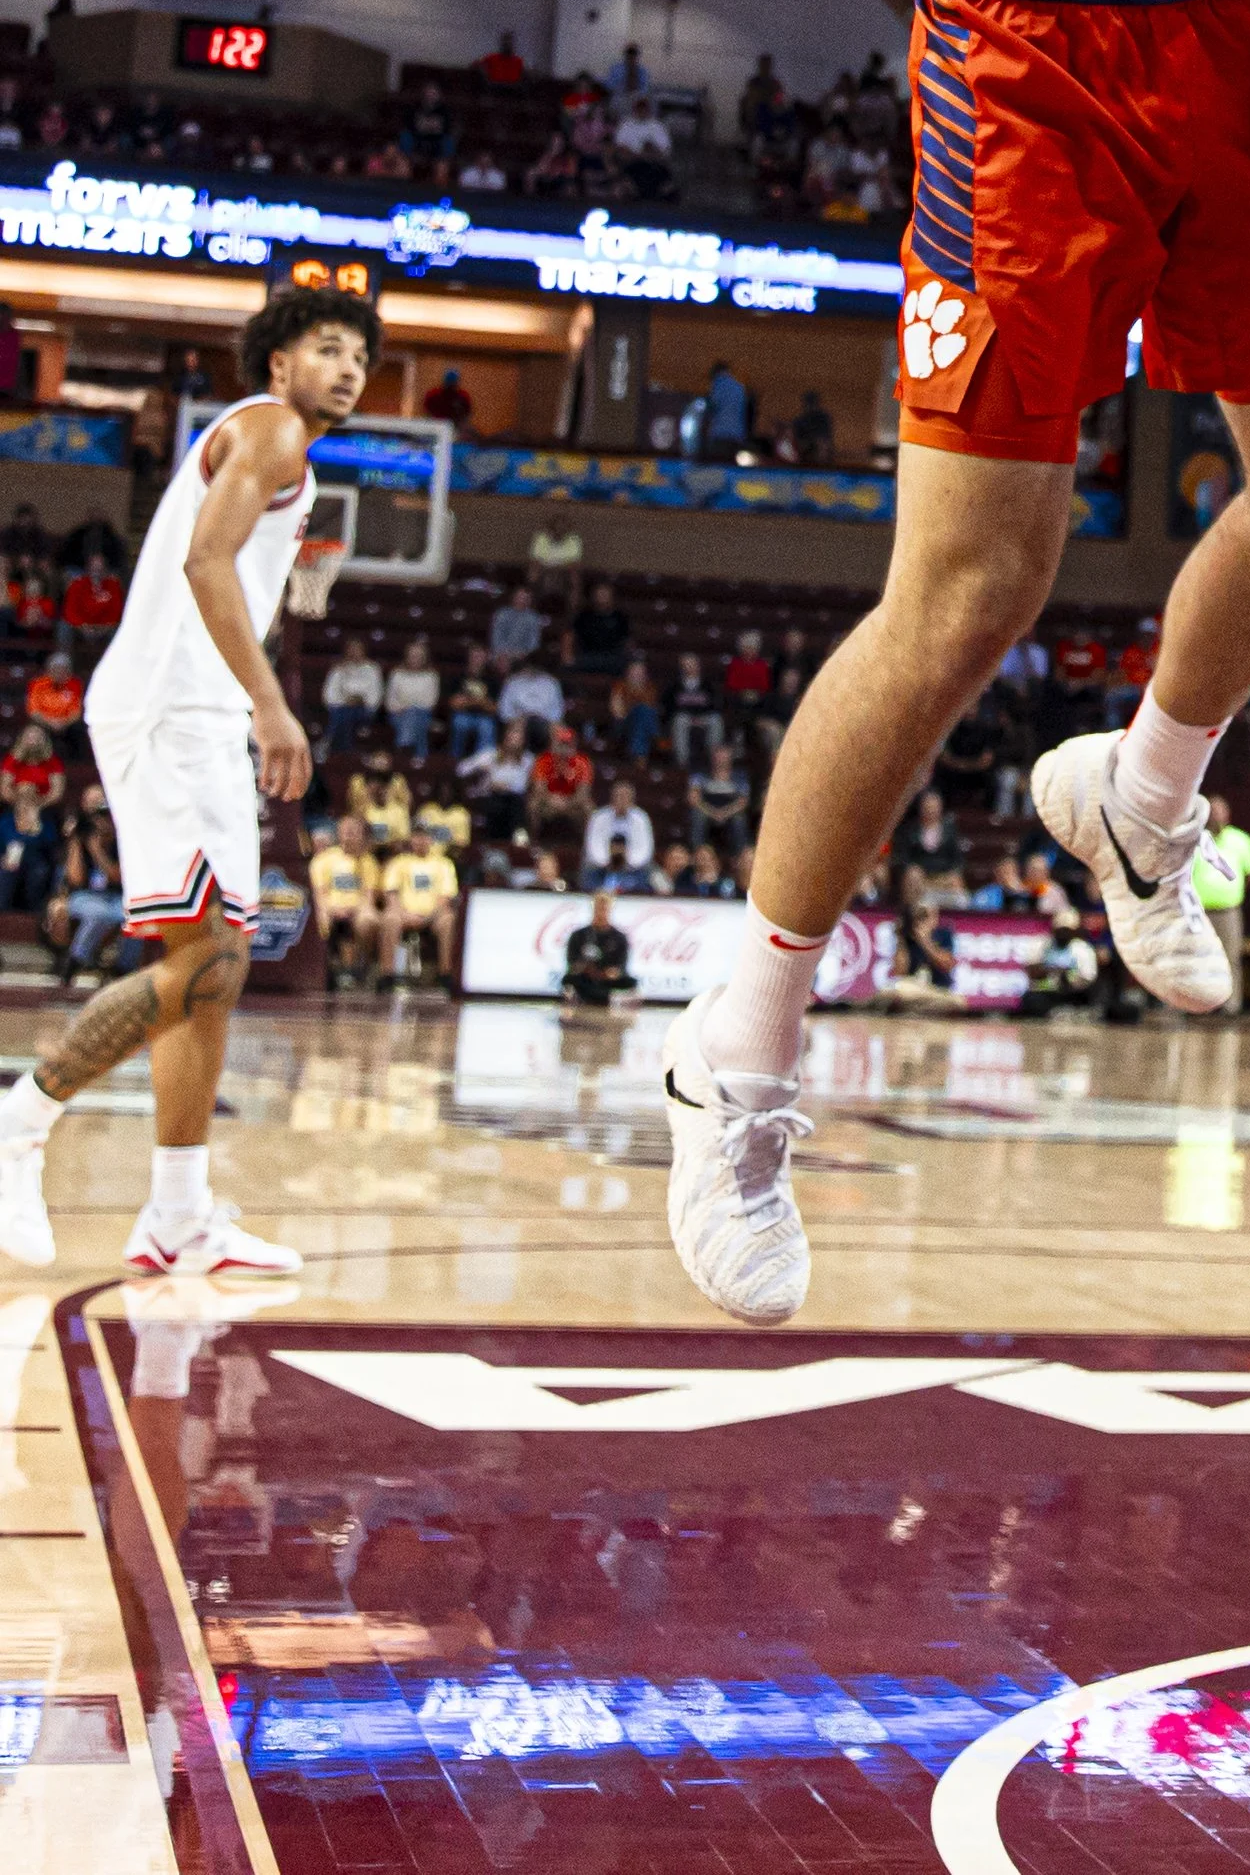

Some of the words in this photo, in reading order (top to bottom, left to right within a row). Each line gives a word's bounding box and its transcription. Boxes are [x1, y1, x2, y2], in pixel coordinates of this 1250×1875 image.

[207, 25, 267, 70] 122
[0, 207, 192, 258] mazars
[534, 255, 719, 303] mazars
